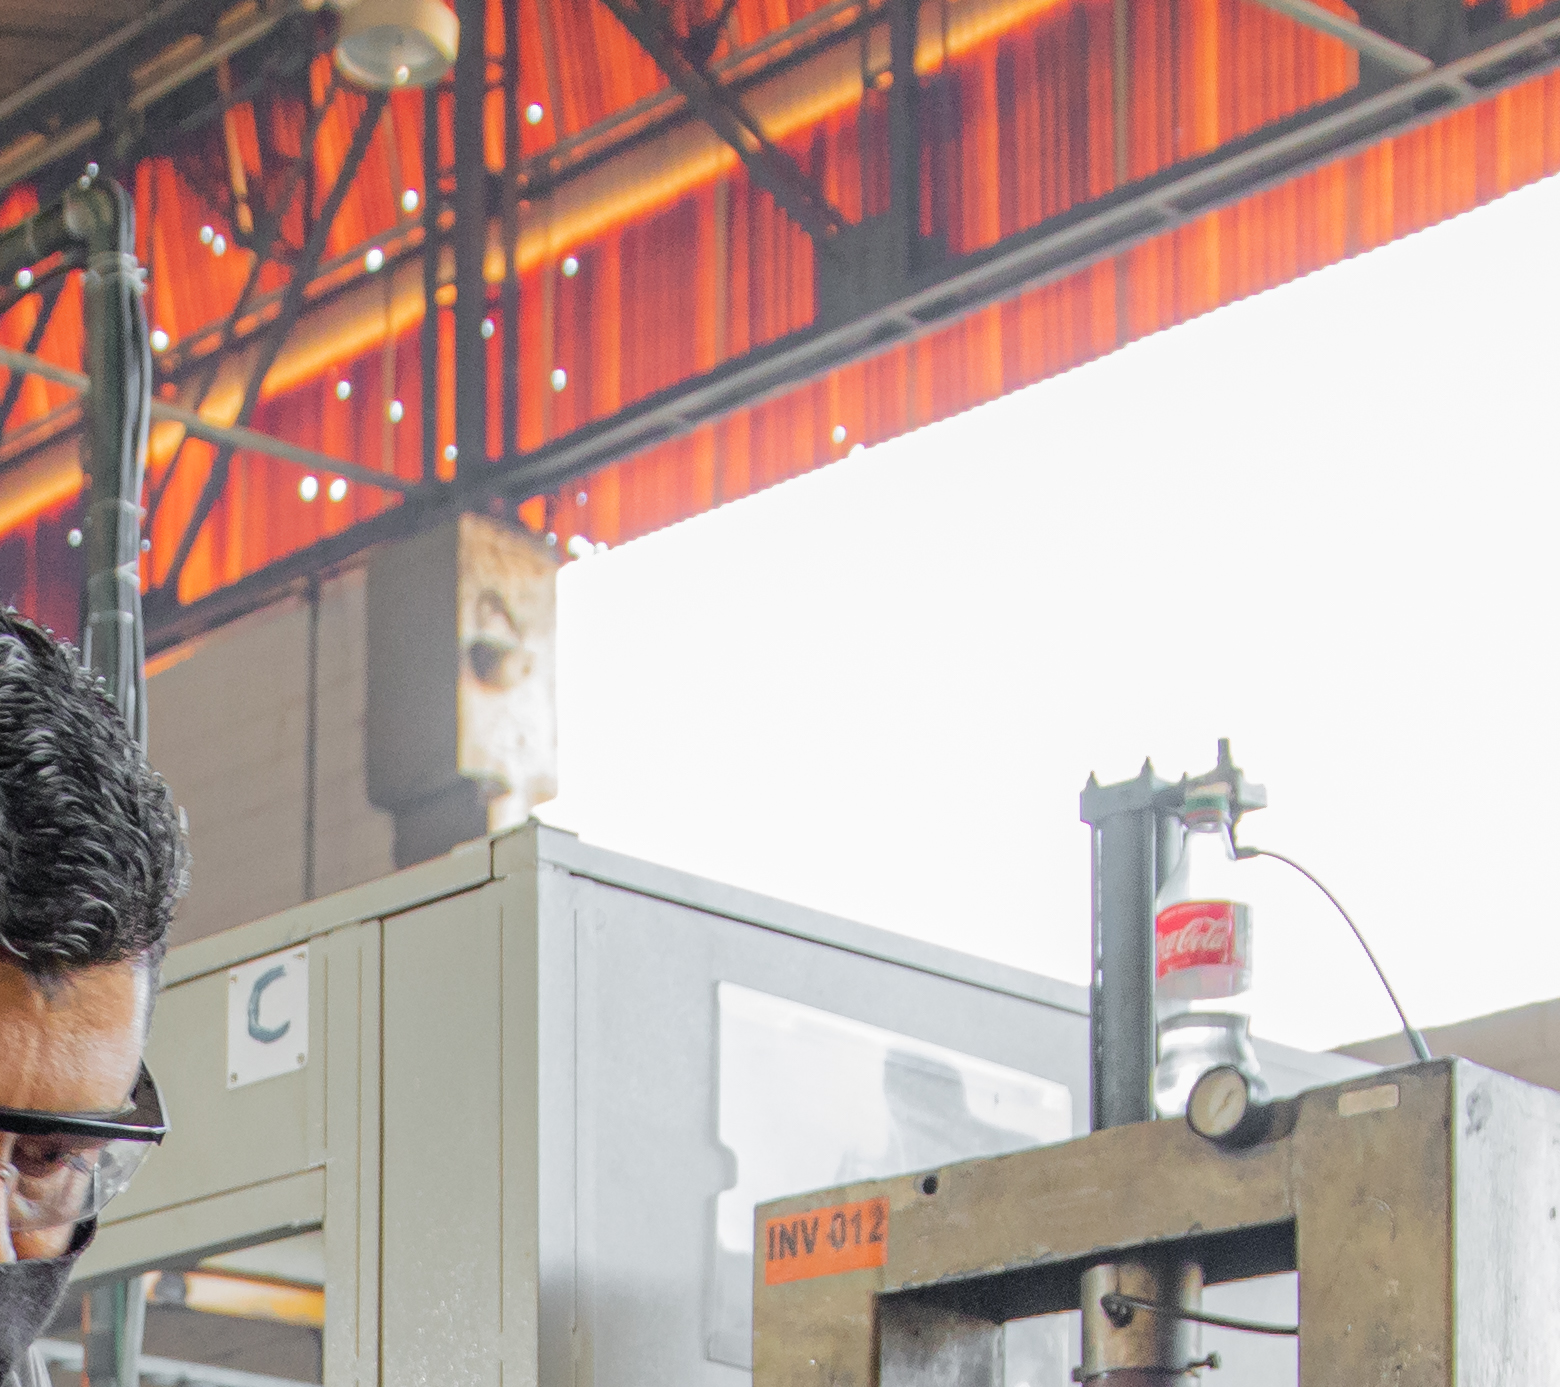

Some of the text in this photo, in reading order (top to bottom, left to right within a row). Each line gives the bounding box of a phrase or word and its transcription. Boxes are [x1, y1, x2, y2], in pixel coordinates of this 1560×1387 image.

[248, 965, 291, 1044] C
[768, 1201, 884, 1261] INV 012
